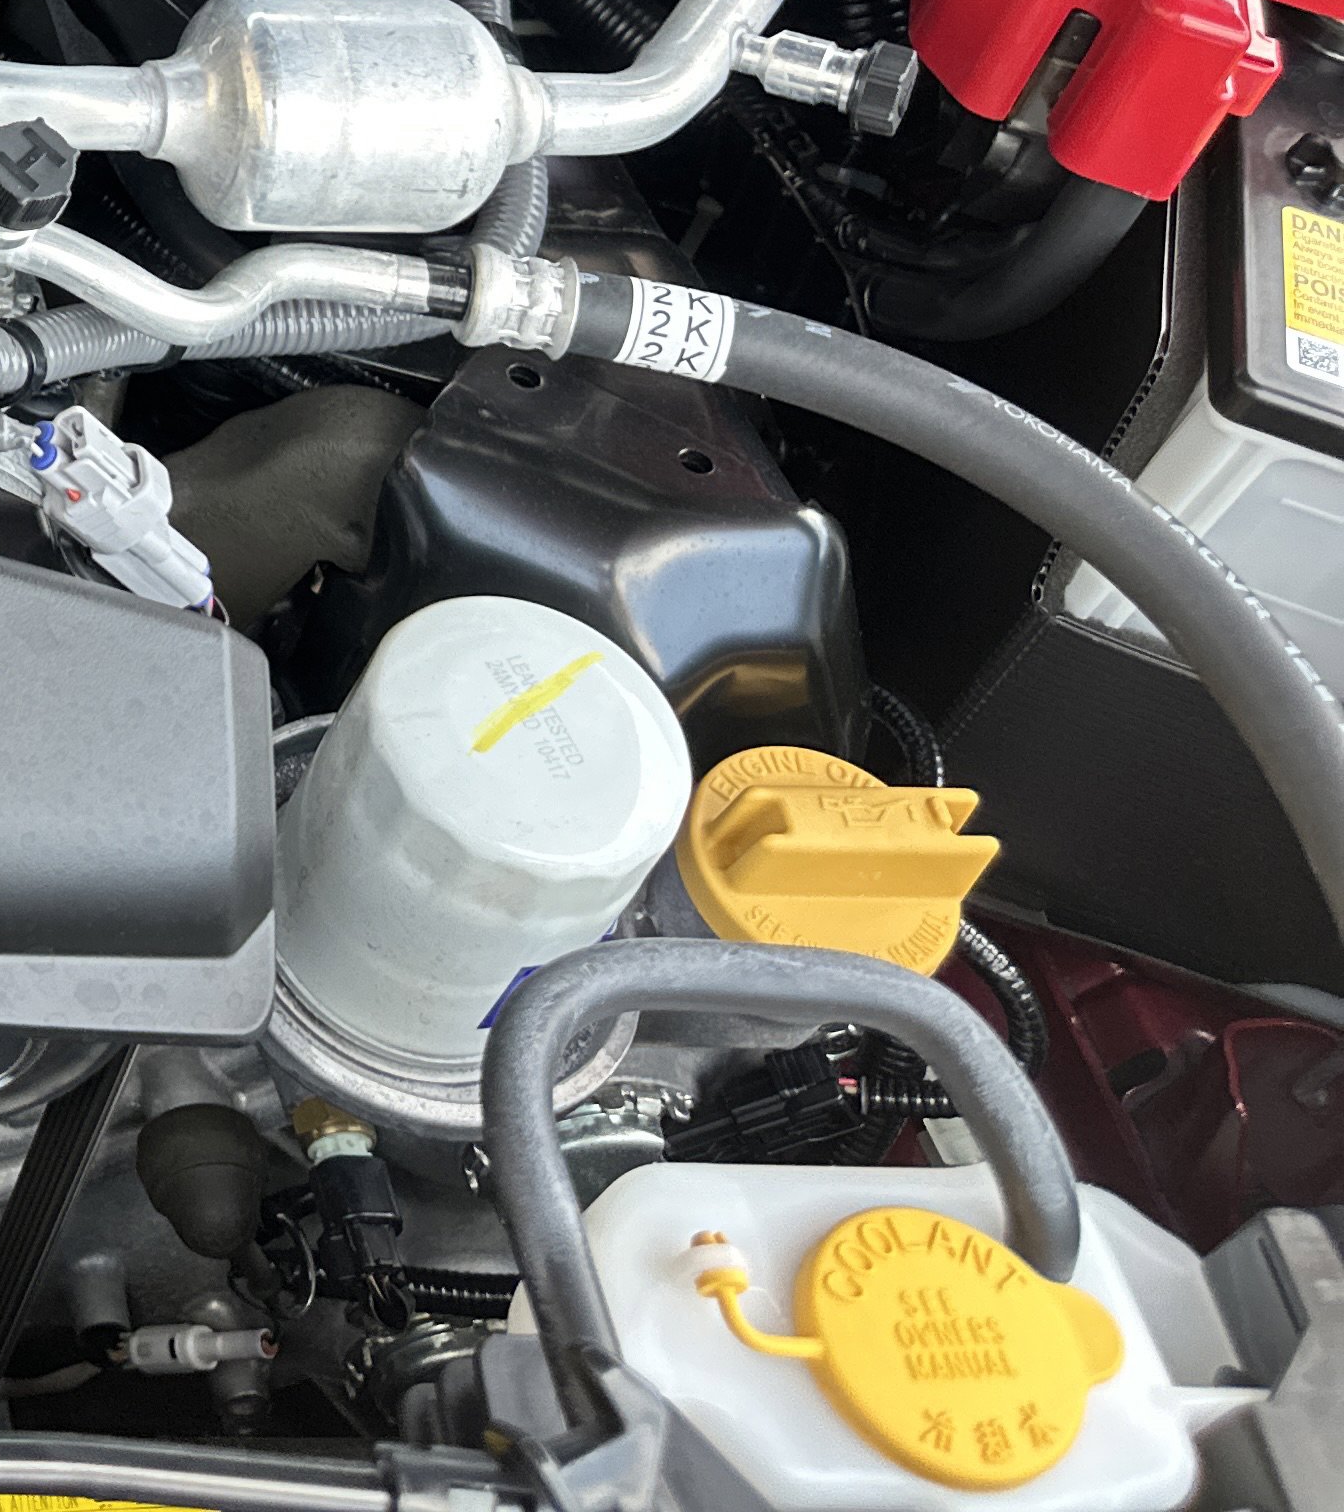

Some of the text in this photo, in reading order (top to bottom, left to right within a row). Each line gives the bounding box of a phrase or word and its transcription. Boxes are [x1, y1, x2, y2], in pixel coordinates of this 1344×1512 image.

[1292, 214, 1344, 243] DAN
[990, 395, 1133, 493] YOKOHAMA
[506, 654, 584, 766] LEA TESTED
[709, 749, 818, 802] ENGINE
[821, 1216, 1028, 1303] COOLANT
[897, 1287, 957, 1317] SEE
[903, 1349, 1018, 1381] MANUAL
